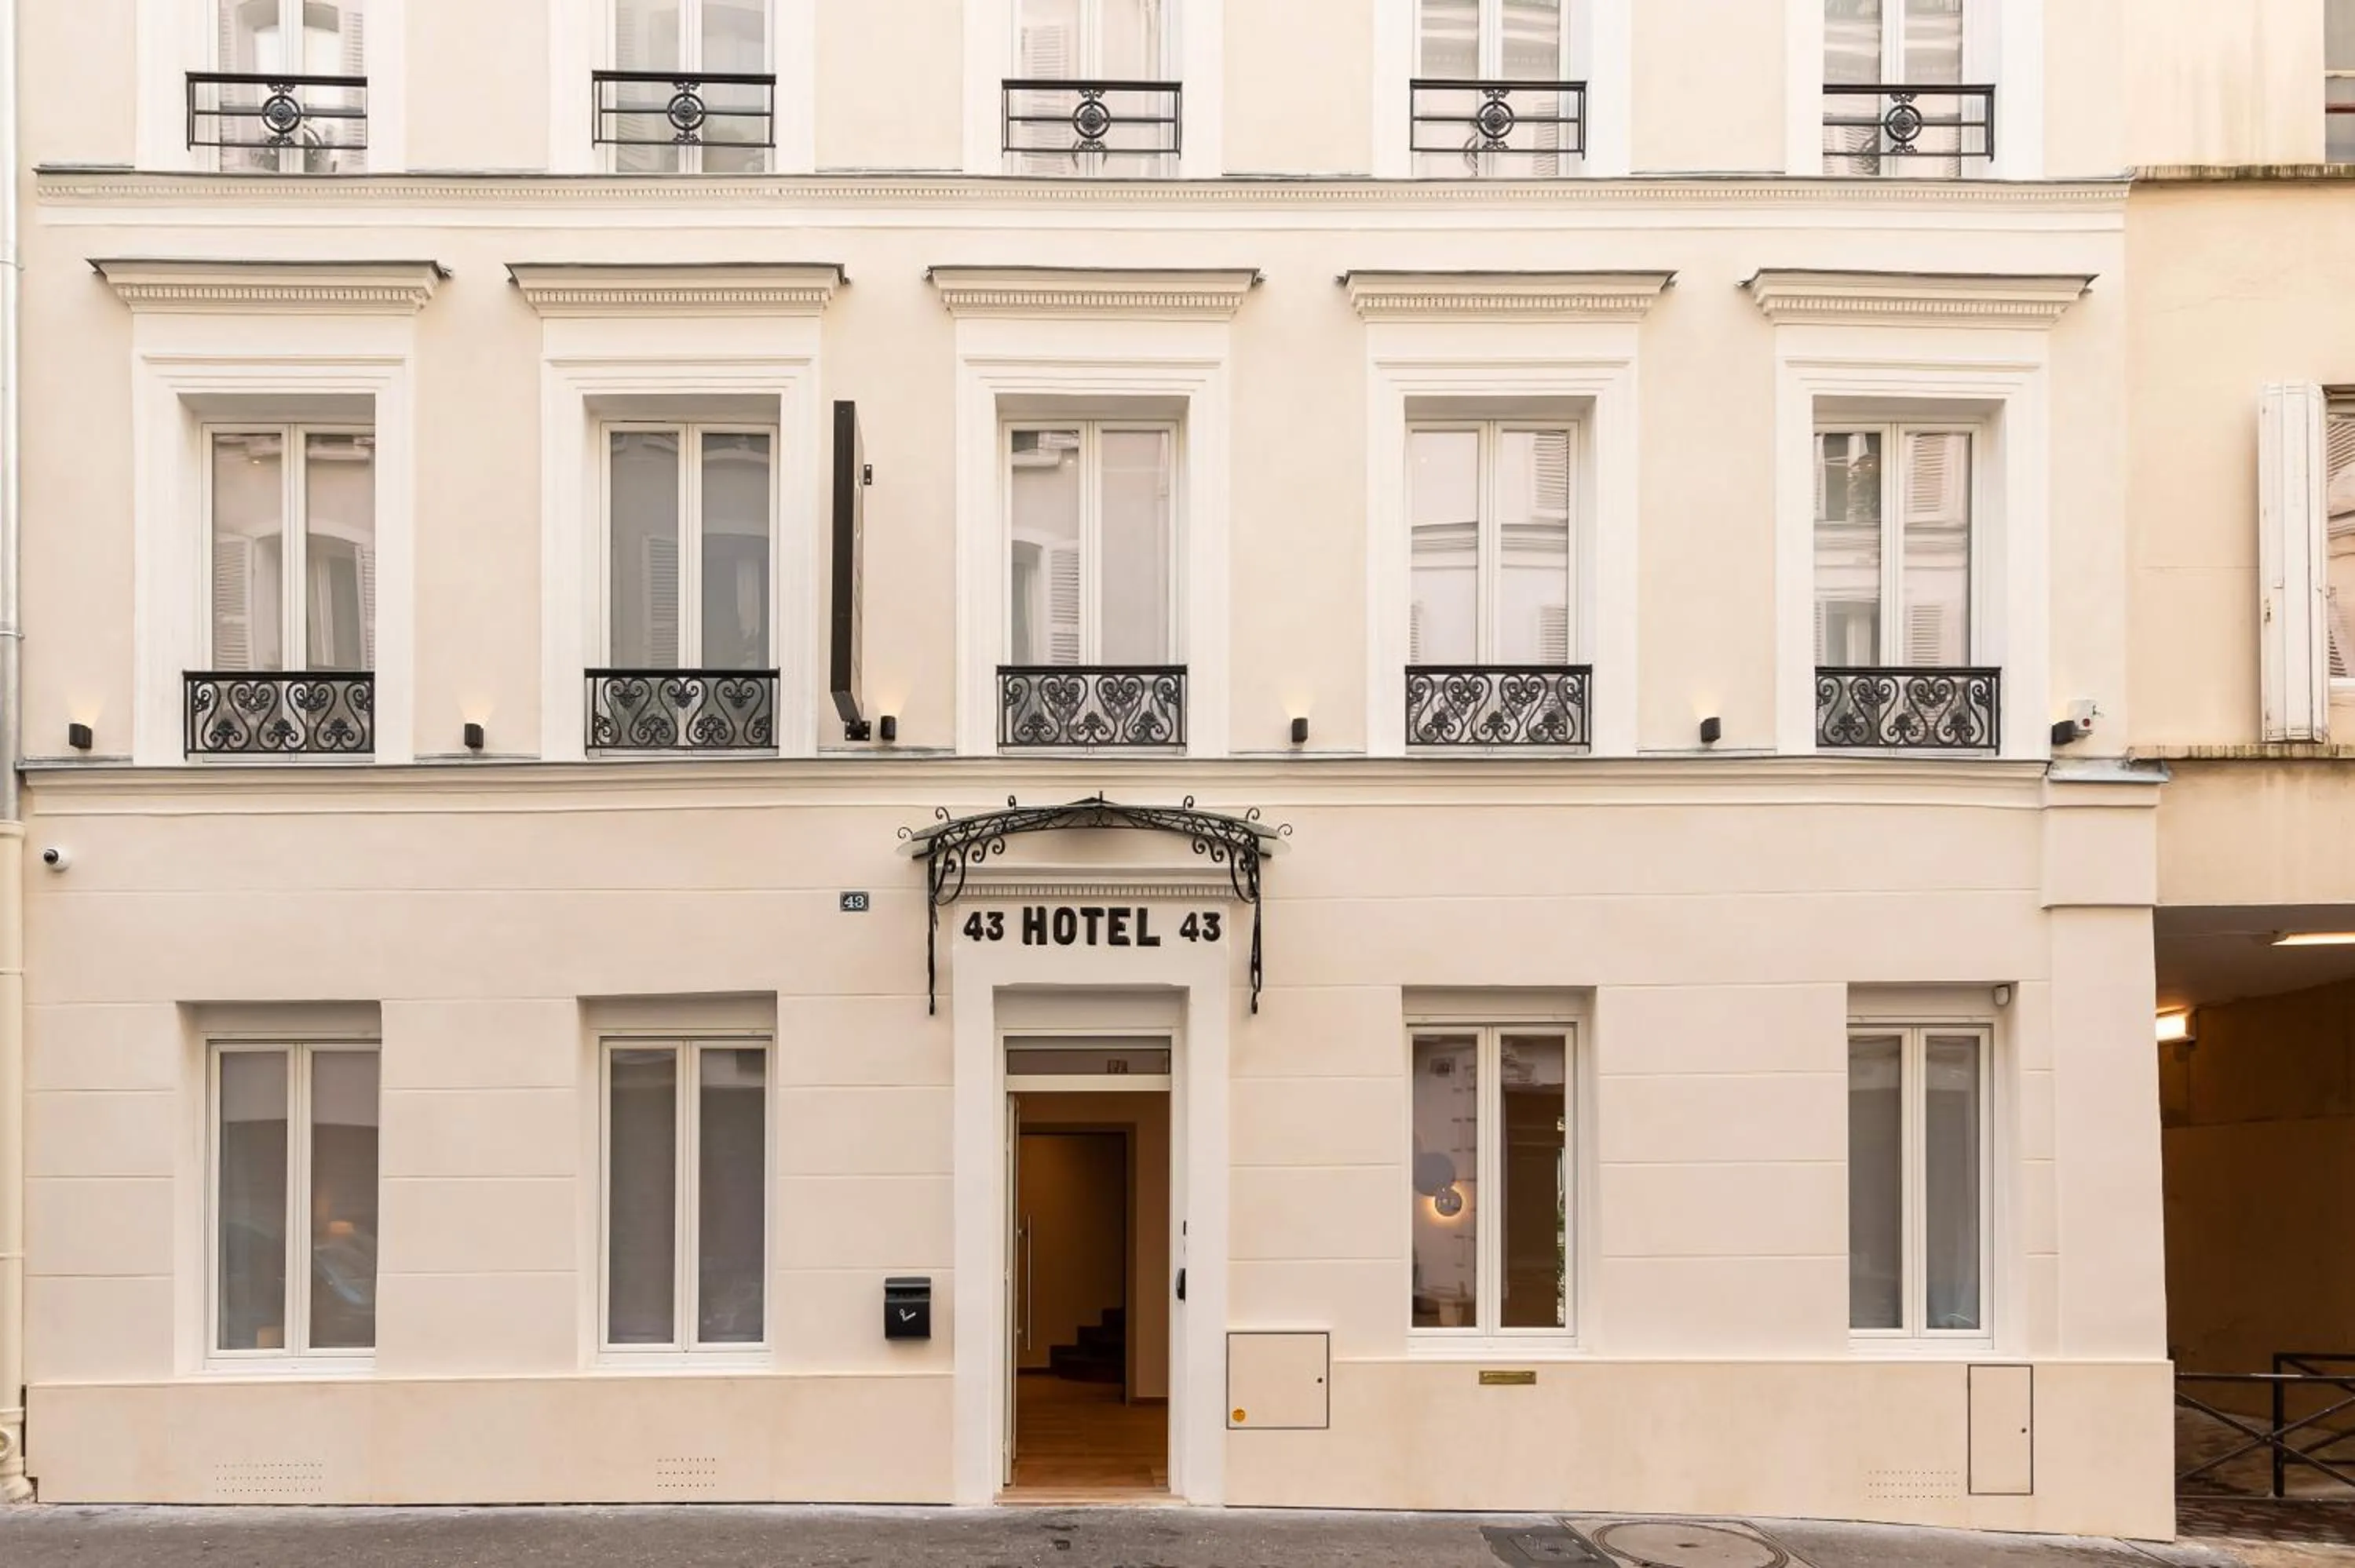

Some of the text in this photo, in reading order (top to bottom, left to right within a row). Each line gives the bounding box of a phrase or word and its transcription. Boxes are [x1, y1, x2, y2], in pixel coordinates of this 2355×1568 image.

[844, 895, 864, 908] 43
[963, 906, 1221, 946] 43 HOTEL 43
